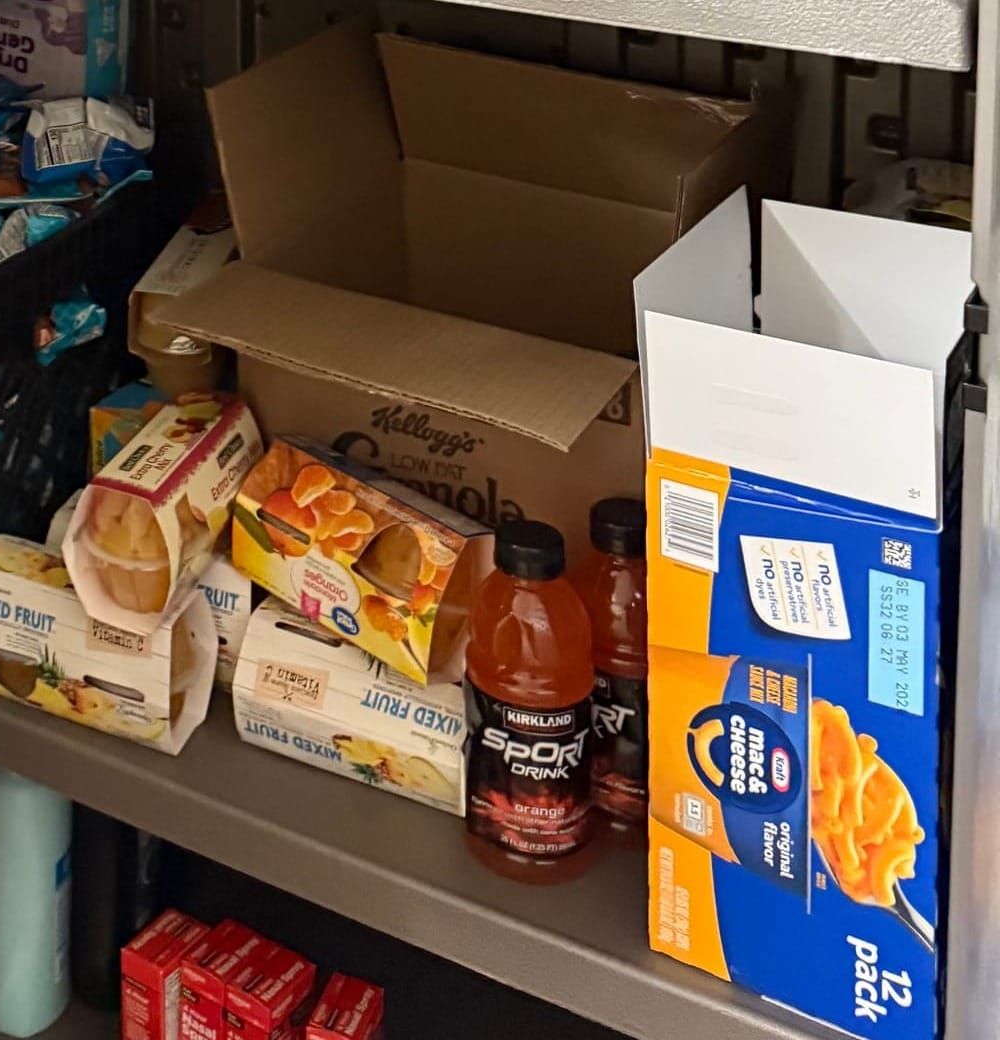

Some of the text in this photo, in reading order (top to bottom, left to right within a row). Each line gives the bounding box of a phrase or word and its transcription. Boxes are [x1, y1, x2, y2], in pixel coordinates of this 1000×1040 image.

[372, 405, 477, 457] Kellogg's
[129, 444, 174, 480] Extra Cherry
[154, 458, 173, 471] Mix
[391, 453, 467, 481] LOW FAT
[211, 478, 229, 501] Extra
[304, 569, 348, 602] Oranges
[755, 577, 766, 600] dyes
[761, 558, 782, 621] no artificial
[779, 560, 799, 623] preservatives
[790, 561, 811, 624] no artificial
[811, 579, 823, 612] flavors
[817, 564, 839, 628] no artificial
[15, 605, 56, 633] FRUIT
[880, 585, 893, 664] SS32 06 27
[896, 604, 909, 621] BY
[92, 621, 144, 652] Vitamin C
[896, 625, 909, 642] 03
[265, 665, 273, 677] C
[749, 664, 764, 689] SAUCE
[896, 648, 909, 675] MAY
[277, 668, 320, 693] Vitamin
[782, 674, 798, 714] MACARONI
[896, 682, 909, 708] 202
[360, 689, 410, 720] FRUIT
[507, 710, 572, 727] KIRKLAND
[244, 720, 342, 762] MIXED FRUIT
[481, 727, 589, 768] SPORT
[510, 762, 570, 781] DRINK
[775, 756, 785, 781] Kraft
[515, 803, 566, 819] orange
[763, 821, 778, 867] flavor
[780, 821, 794, 879] original
[847, 935, 887, 1024] pack
[882, 970, 912, 1008] 12
